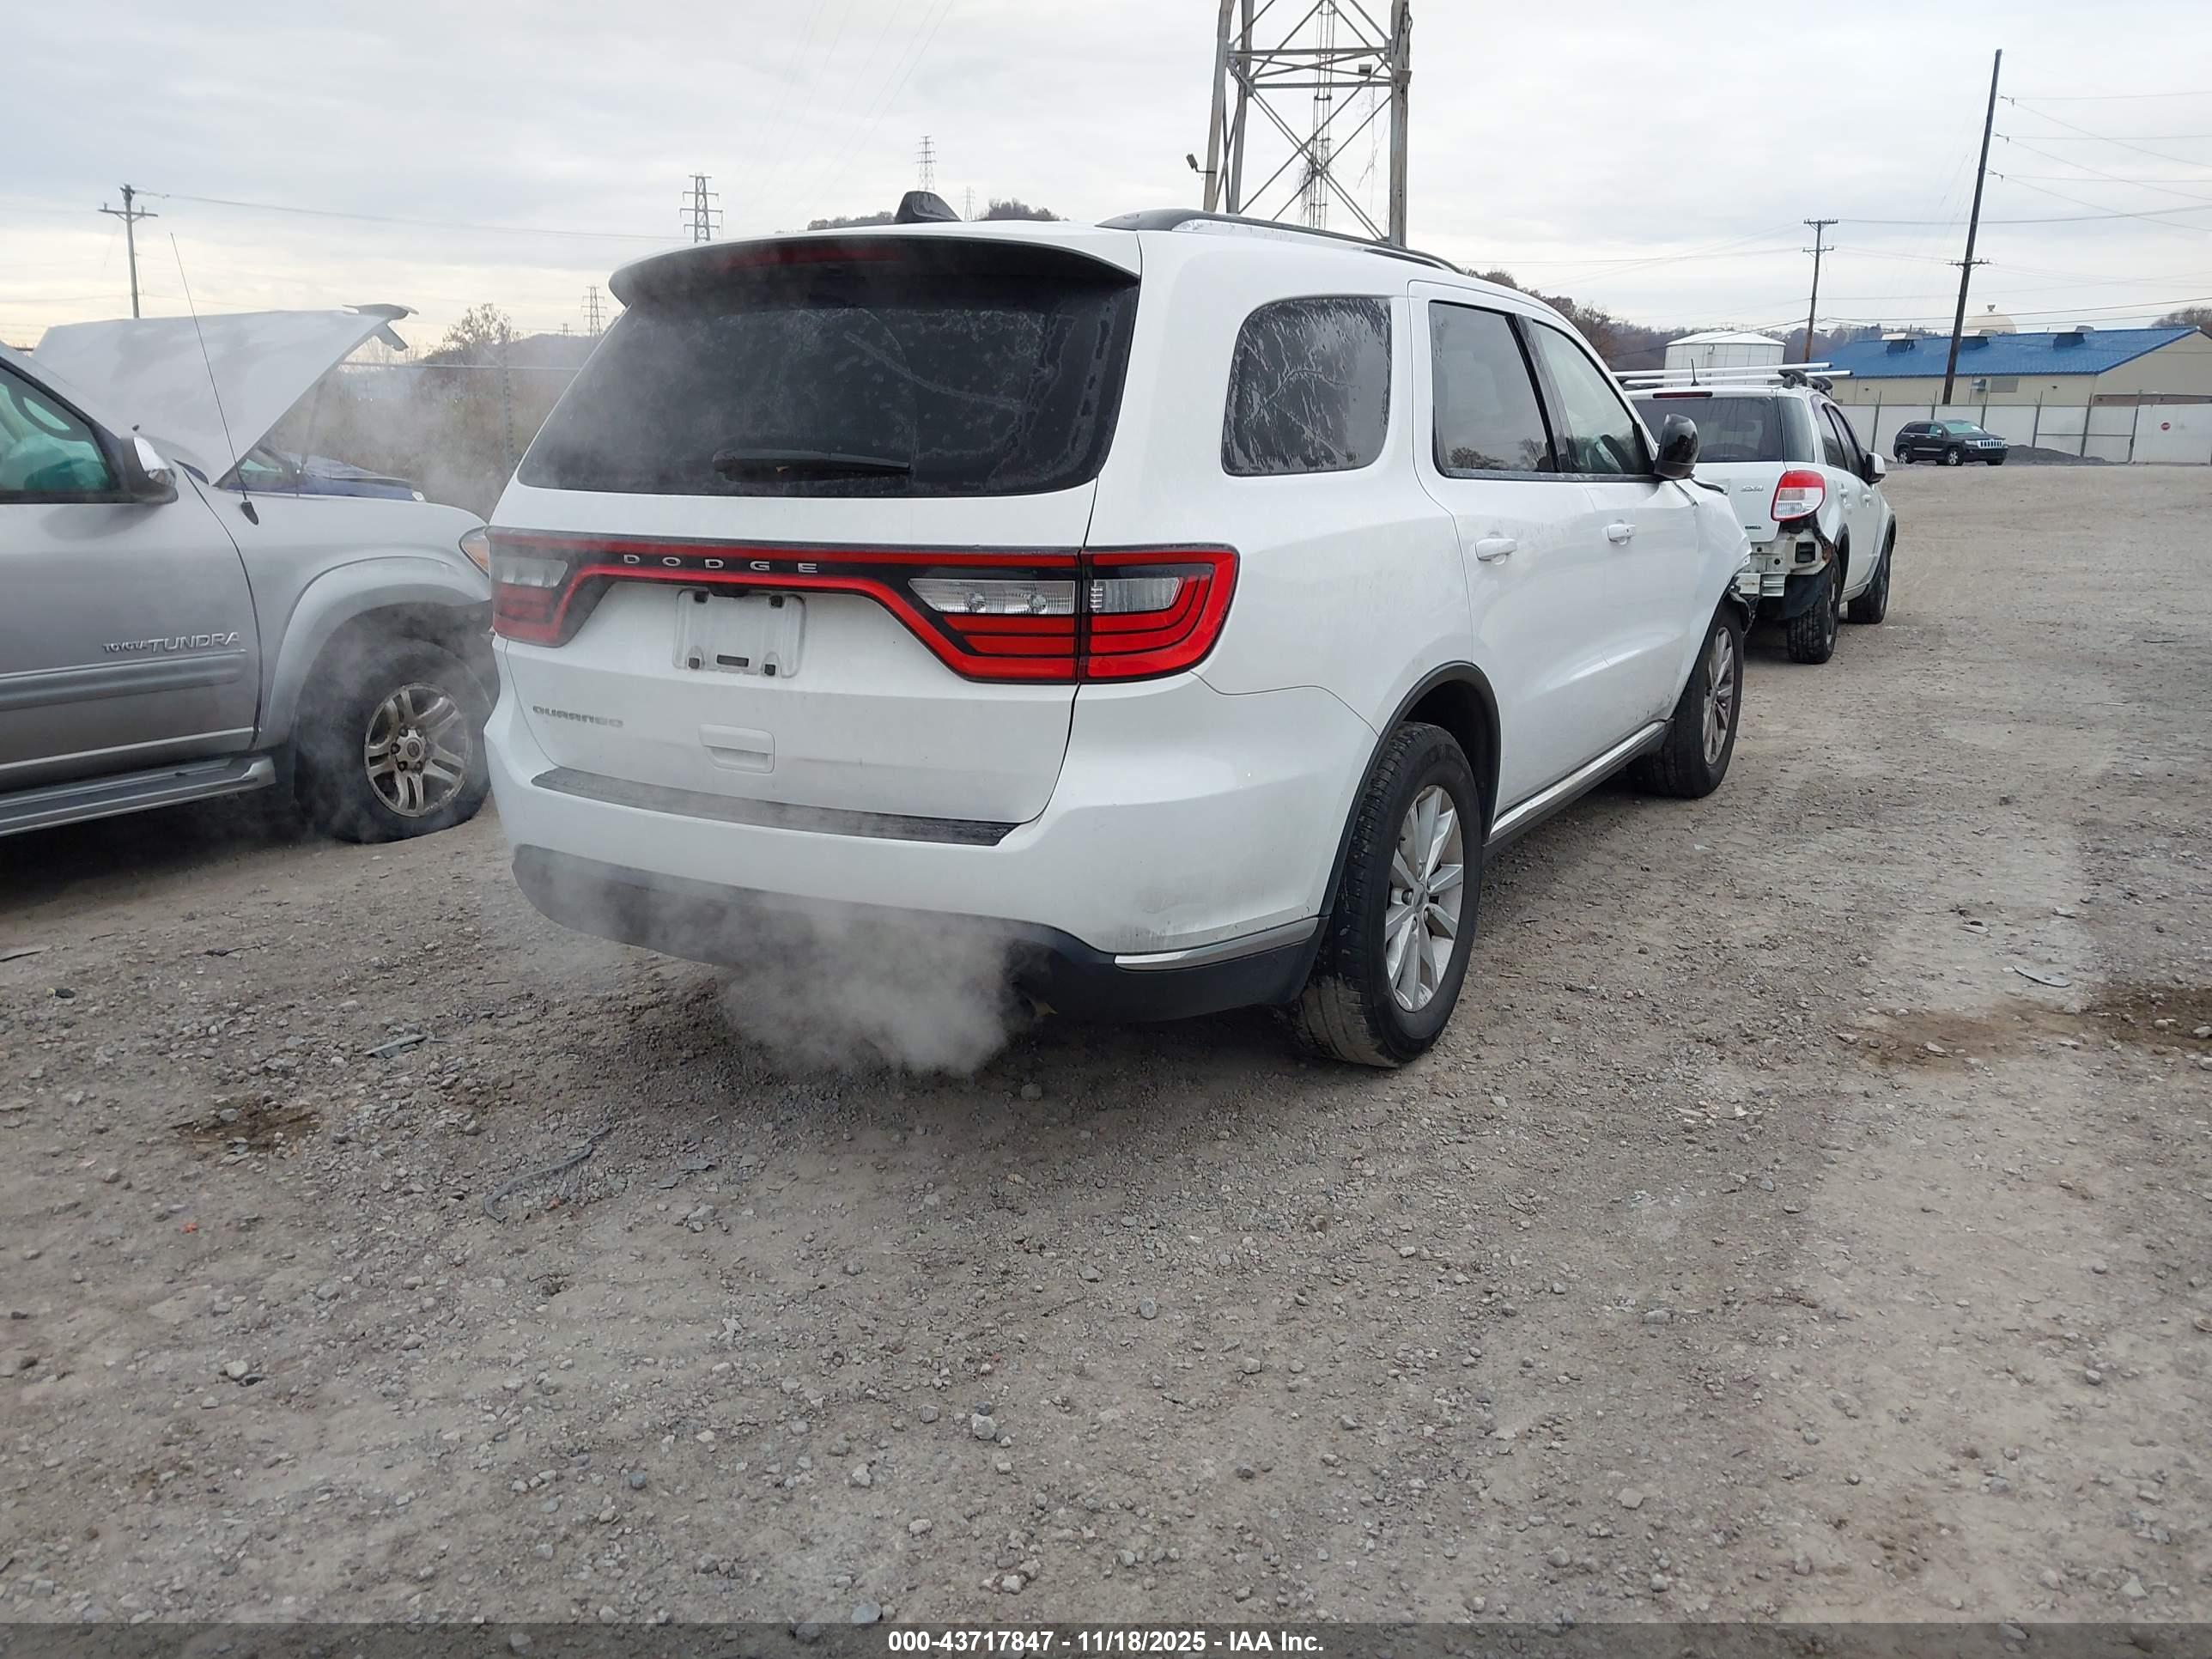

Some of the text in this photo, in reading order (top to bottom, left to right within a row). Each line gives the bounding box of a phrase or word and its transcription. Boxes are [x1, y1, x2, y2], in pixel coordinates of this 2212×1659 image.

[623, 553, 818, 574] DODGE
[102, 631, 241, 653] TOYOTA TUNDRA
